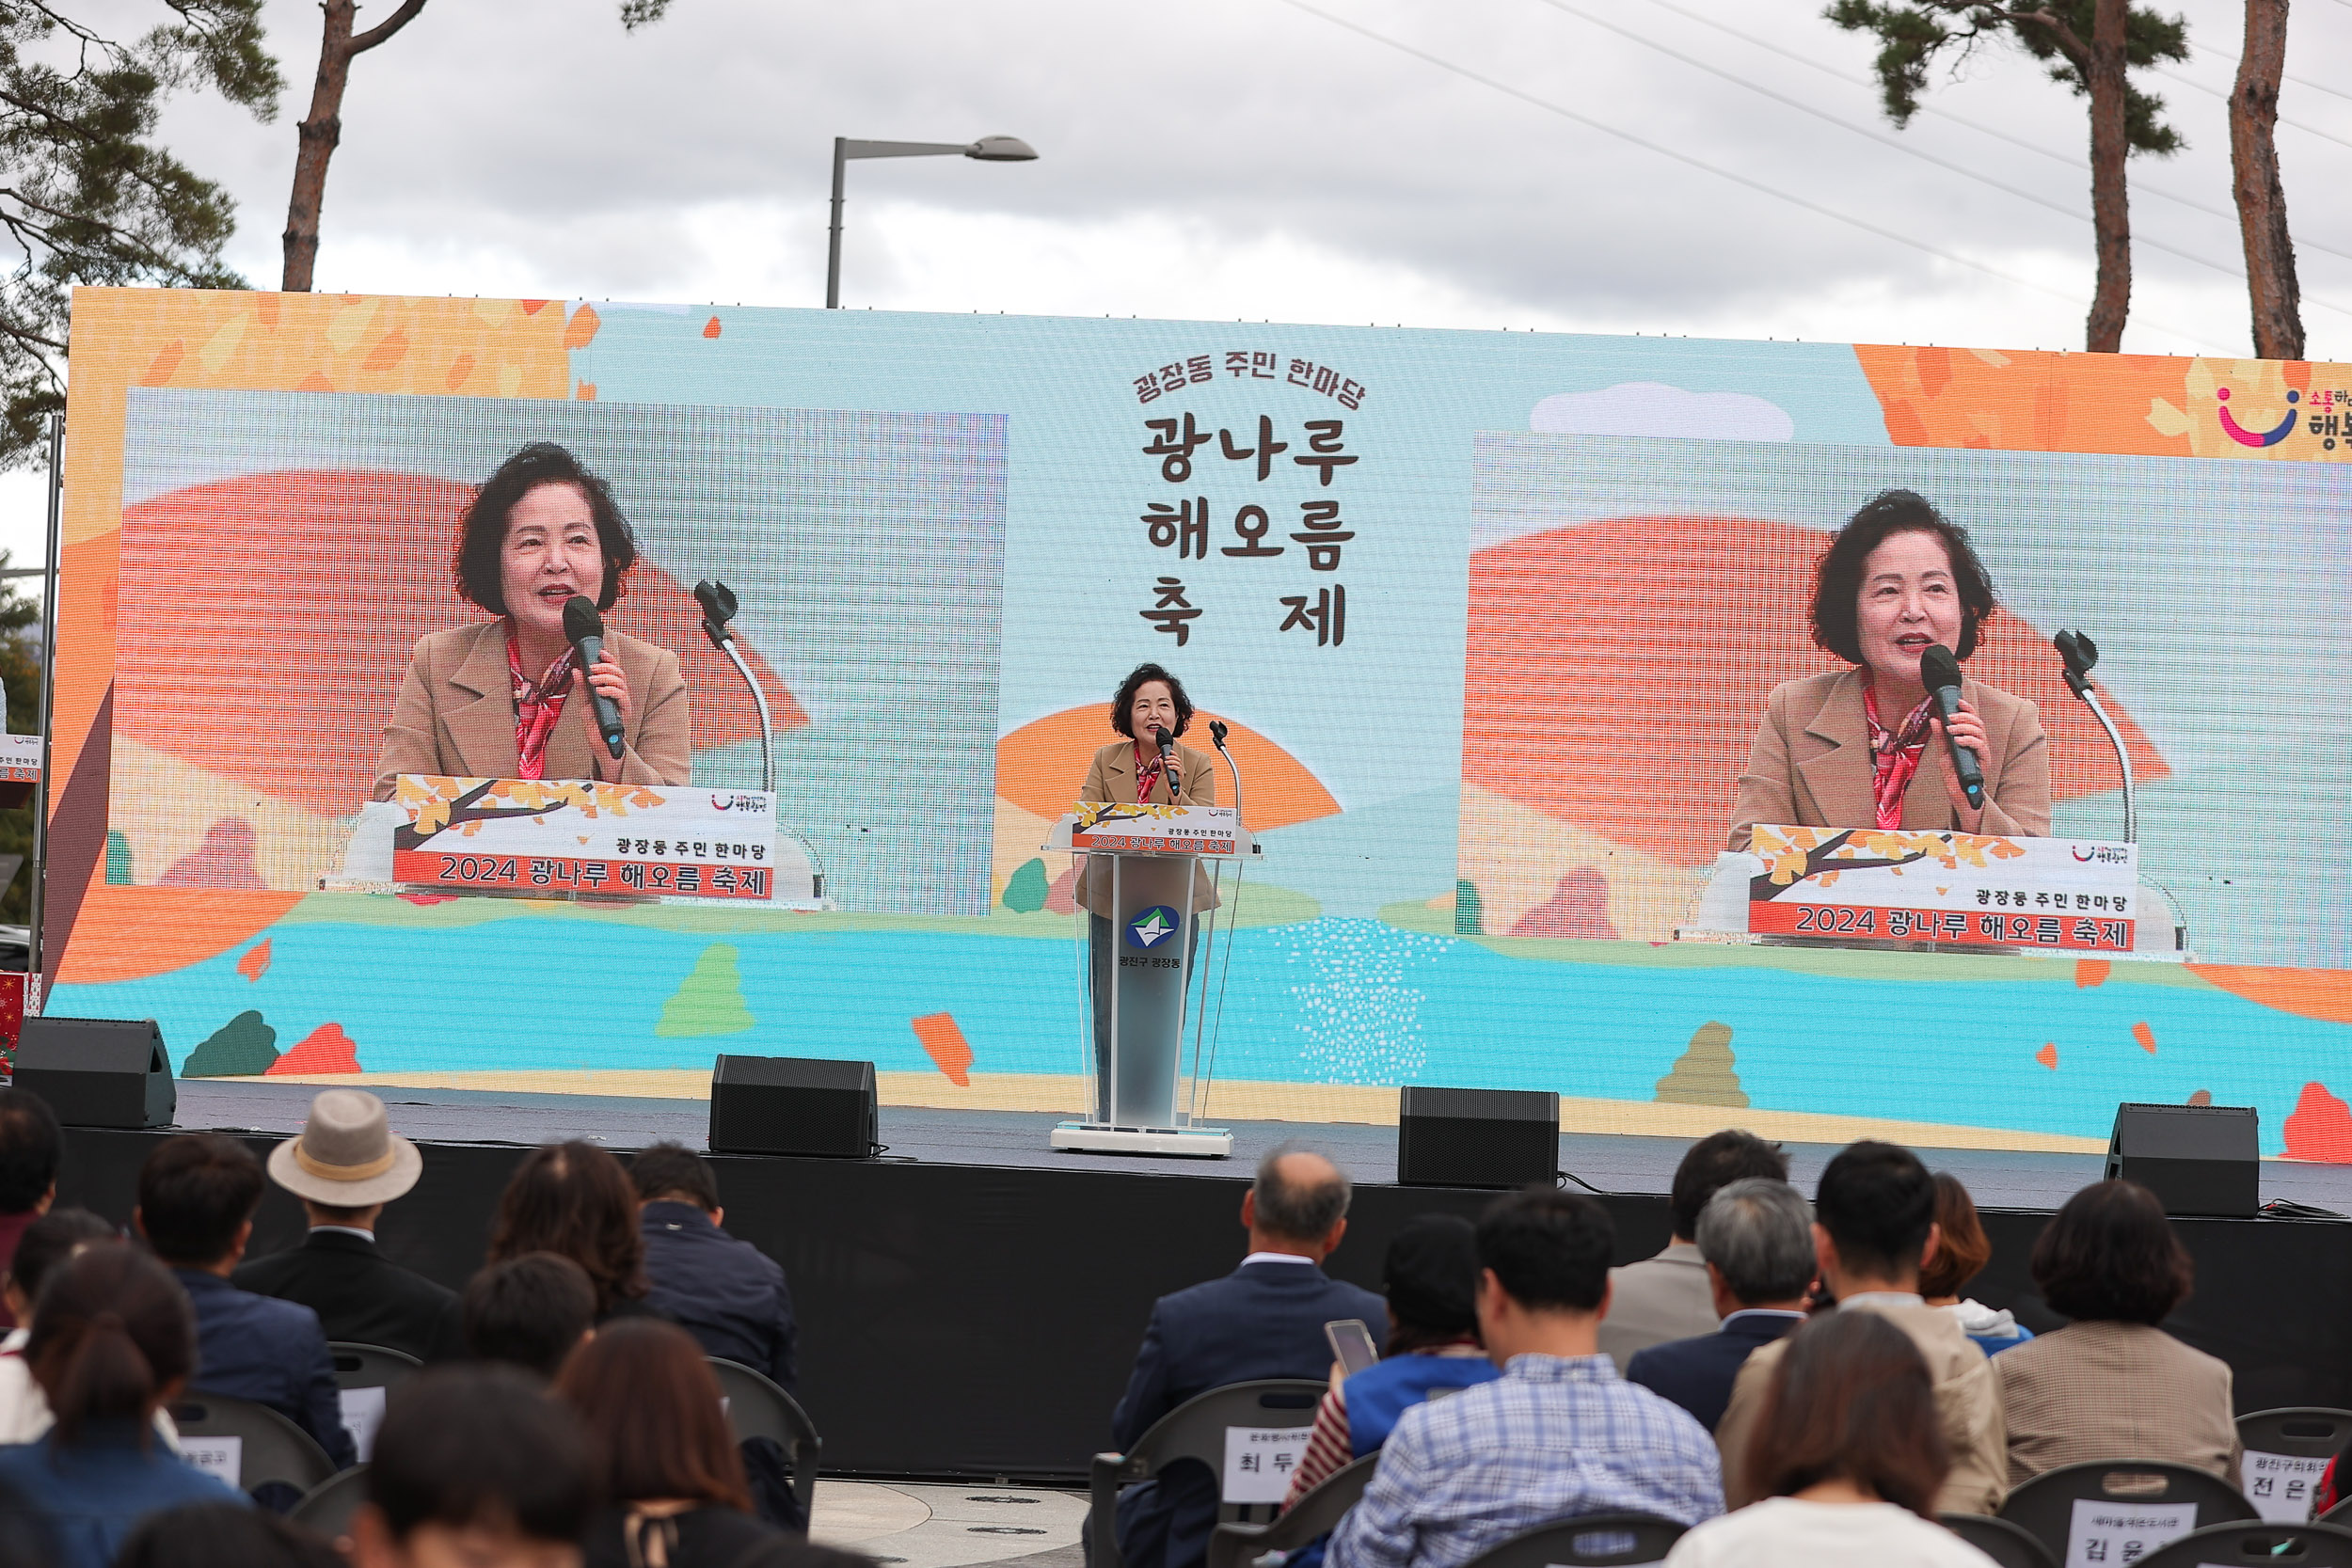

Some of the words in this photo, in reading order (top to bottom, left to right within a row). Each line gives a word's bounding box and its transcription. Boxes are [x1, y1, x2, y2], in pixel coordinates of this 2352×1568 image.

[1133, 354, 1214, 404] 광장동
[1225, 351, 1277, 379] 주민
[1286, 358, 1366, 411] 한마당
[1141, 411, 1359, 487] 광나루
[1139, 496, 1356, 571] 해오름
[13, 767, 38, 781] 축제
[616, 837, 666, 856] 광장동
[674, 840, 707, 858] 주민
[715, 842, 766, 861] 한마당
[1091, 834, 1126, 847] 2024
[1130, 837, 1165, 849] 광나루
[1169, 838, 1204, 851] 해오름
[1208, 839, 1232, 852] 축제
[438, 855, 517, 883] 2024
[528, 859, 610, 887] 광나루
[620, 861, 703, 892] 해오름
[711, 864, 767, 896] 축제
[1976, 888, 2027, 908] 광장동
[2035, 891, 2068, 909] 주민
[2076, 893, 2127, 912] 한마당
[1795, 906, 1875, 934] 2024
[1885, 910, 1968, 939] 광나루
[1979, 912, 2061, 943] 해오름
[2072, 917, 2128, 948] 축제
[1120, 957, 1148, 967] 광진구
[1152, 957, 1181, 969] 광장동
